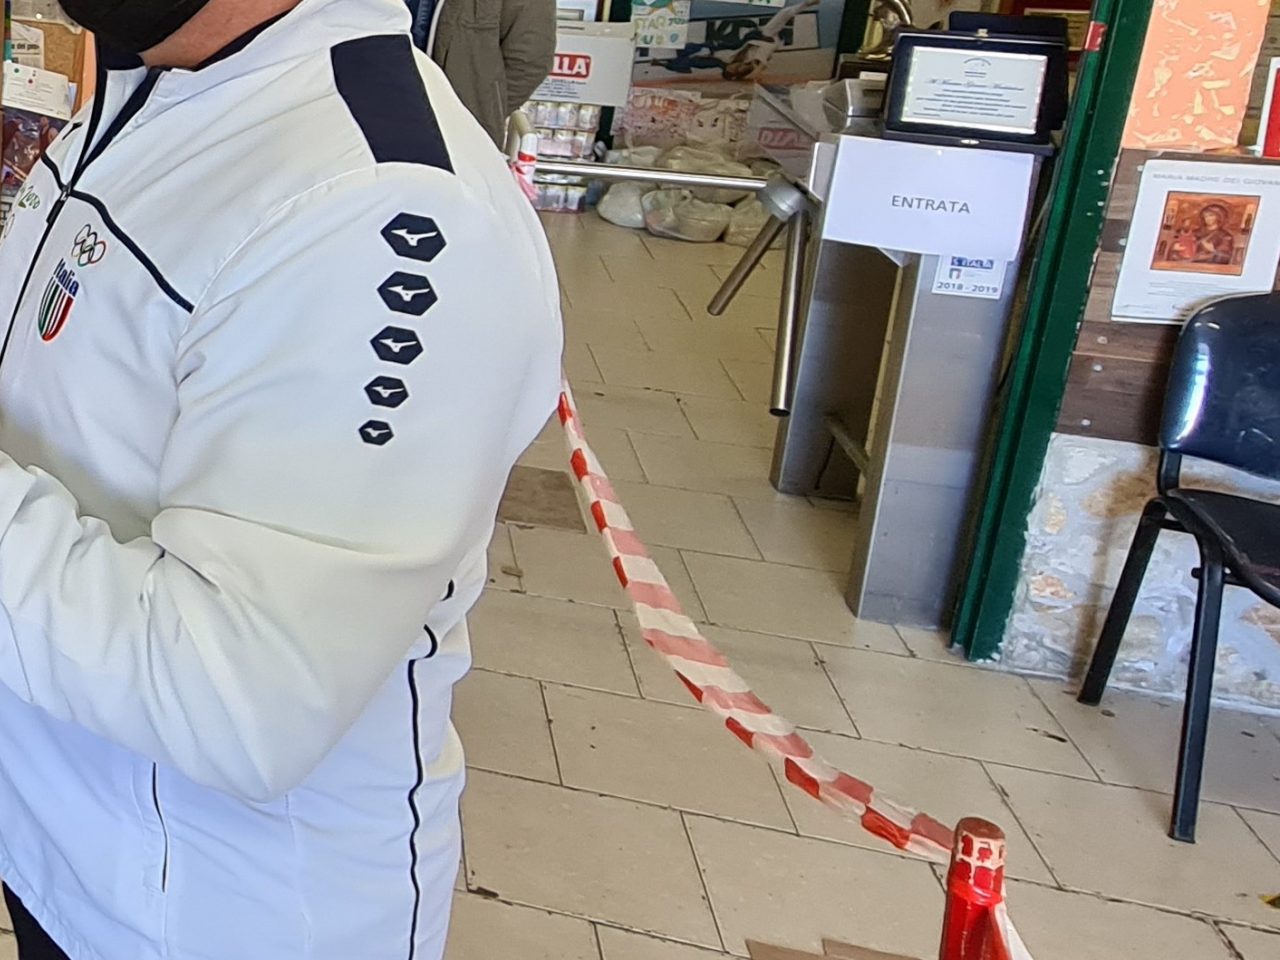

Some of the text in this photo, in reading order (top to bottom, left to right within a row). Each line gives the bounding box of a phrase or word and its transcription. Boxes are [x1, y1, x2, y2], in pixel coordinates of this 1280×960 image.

[891, 194, 970, 214] ENTRATA
[53, 257, 79, 298] Italia
[937, 281, 963, 290] 2018
[972, 284, 998, 293] 2019
